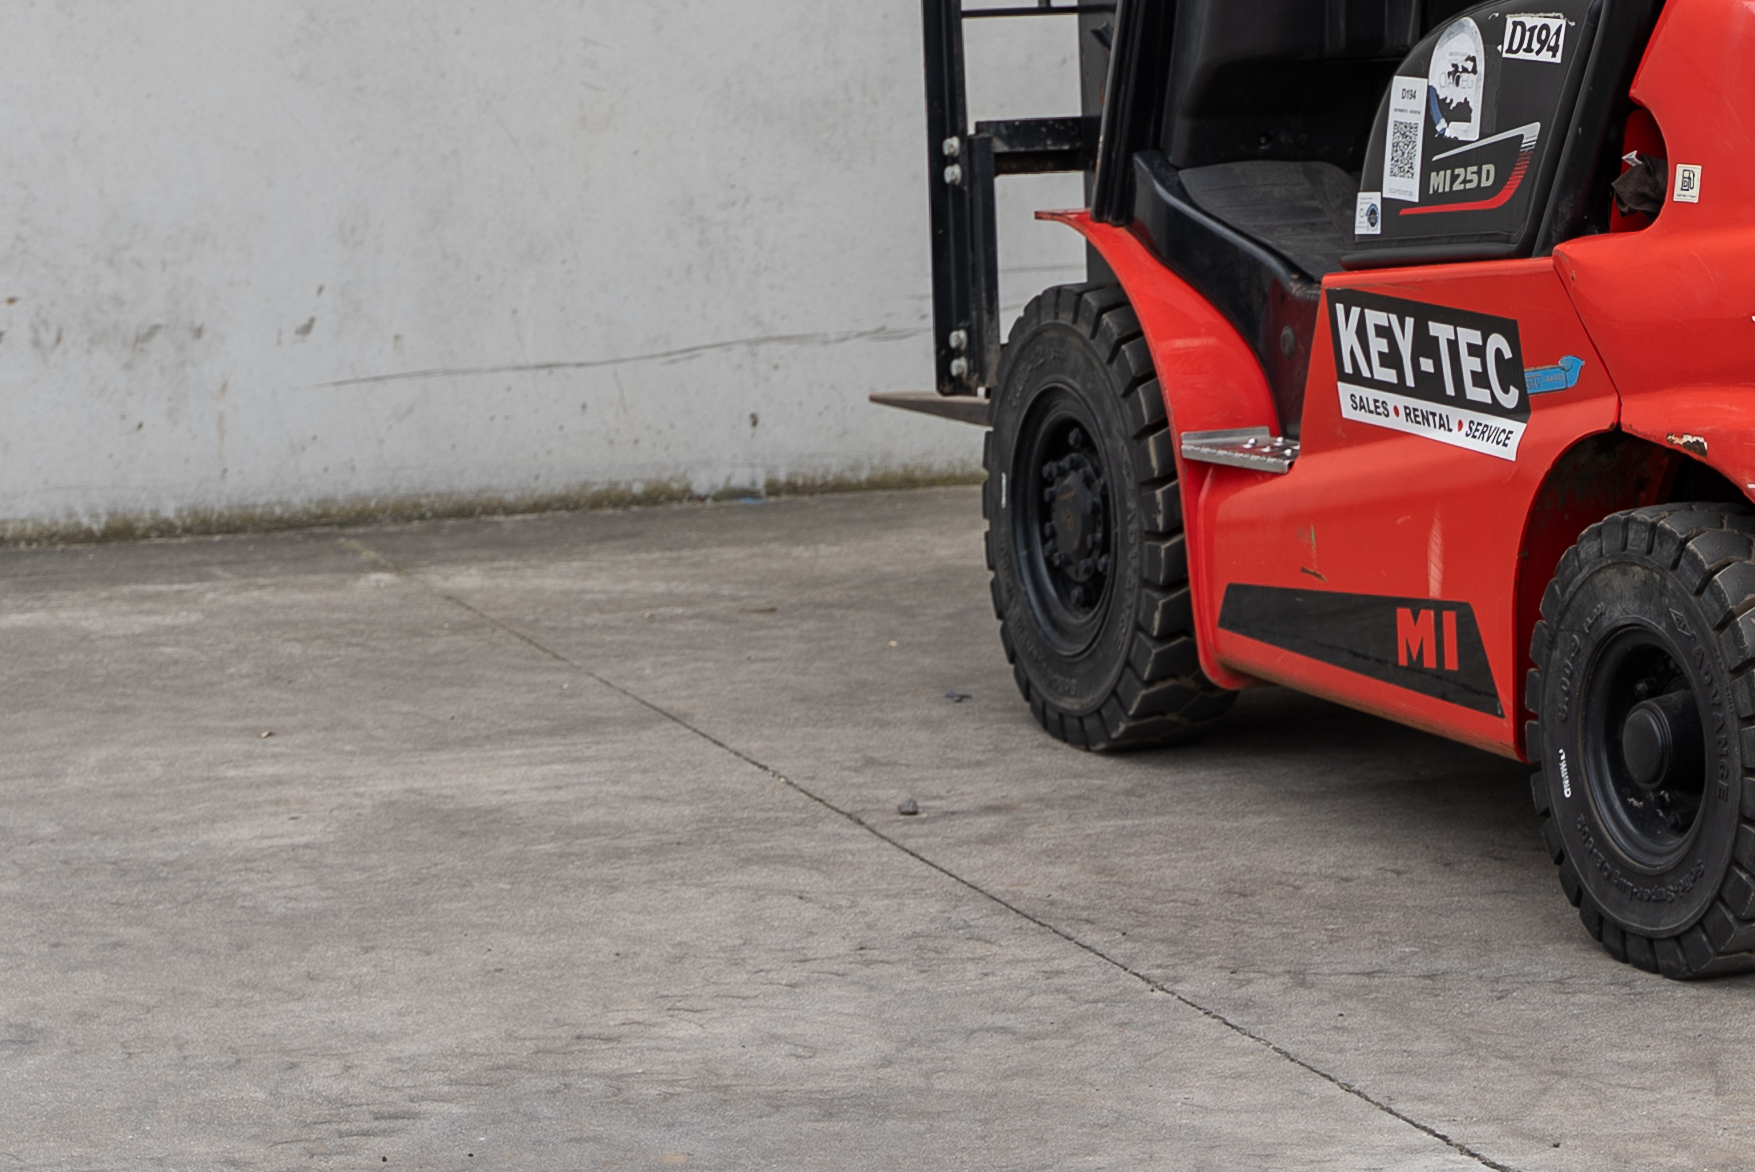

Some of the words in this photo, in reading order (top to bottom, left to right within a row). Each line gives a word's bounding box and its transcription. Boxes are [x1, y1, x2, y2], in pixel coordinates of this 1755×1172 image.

[1505, 20, 1564, 59] D194
[1335, 302, 1520, 410] KEY-TEC
[1350, 393, 1390, 419] SALES
[1404, 406, 1454, 434] RENTAL
[1465, 419, 1515, 449] SERVICE
[1396, 607, 1459, 672] MI
